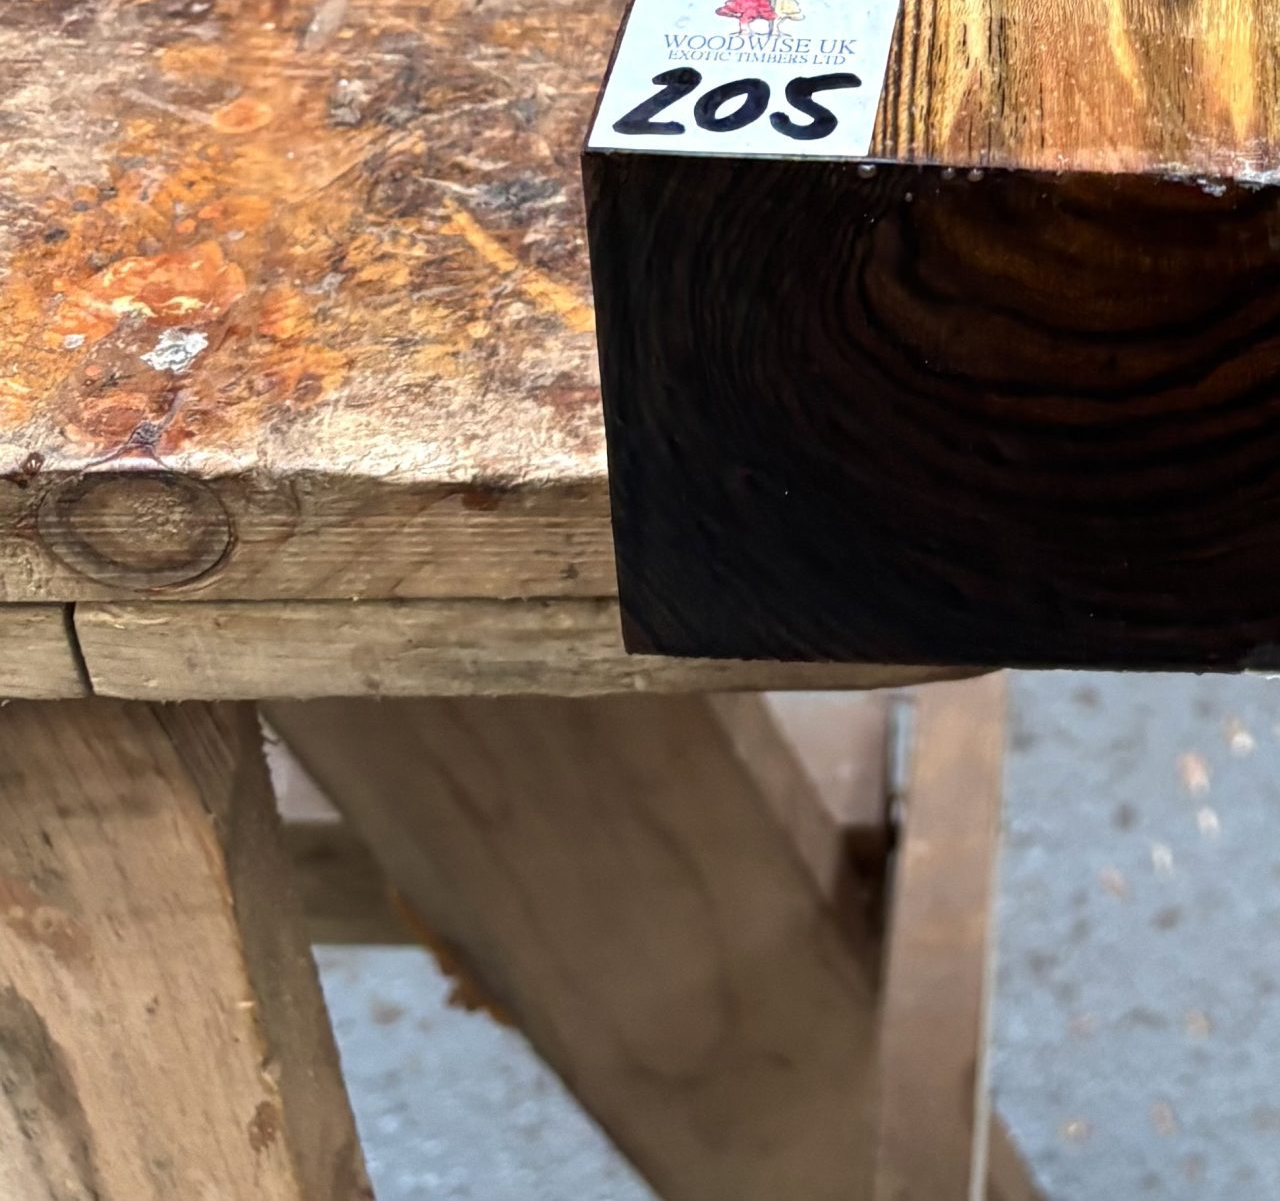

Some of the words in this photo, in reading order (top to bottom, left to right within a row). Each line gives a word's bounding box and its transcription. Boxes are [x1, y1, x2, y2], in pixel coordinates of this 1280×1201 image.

[664, 34, 811, 54] WOODWISE
[820, 39, 857, 55] UK
[668, 49, 730, 61] EXOTIC
[737, 52, 809, 64] TIMBERS
[813, 54, 846, 65] LTD
[612, 66, 862, 140] 205
